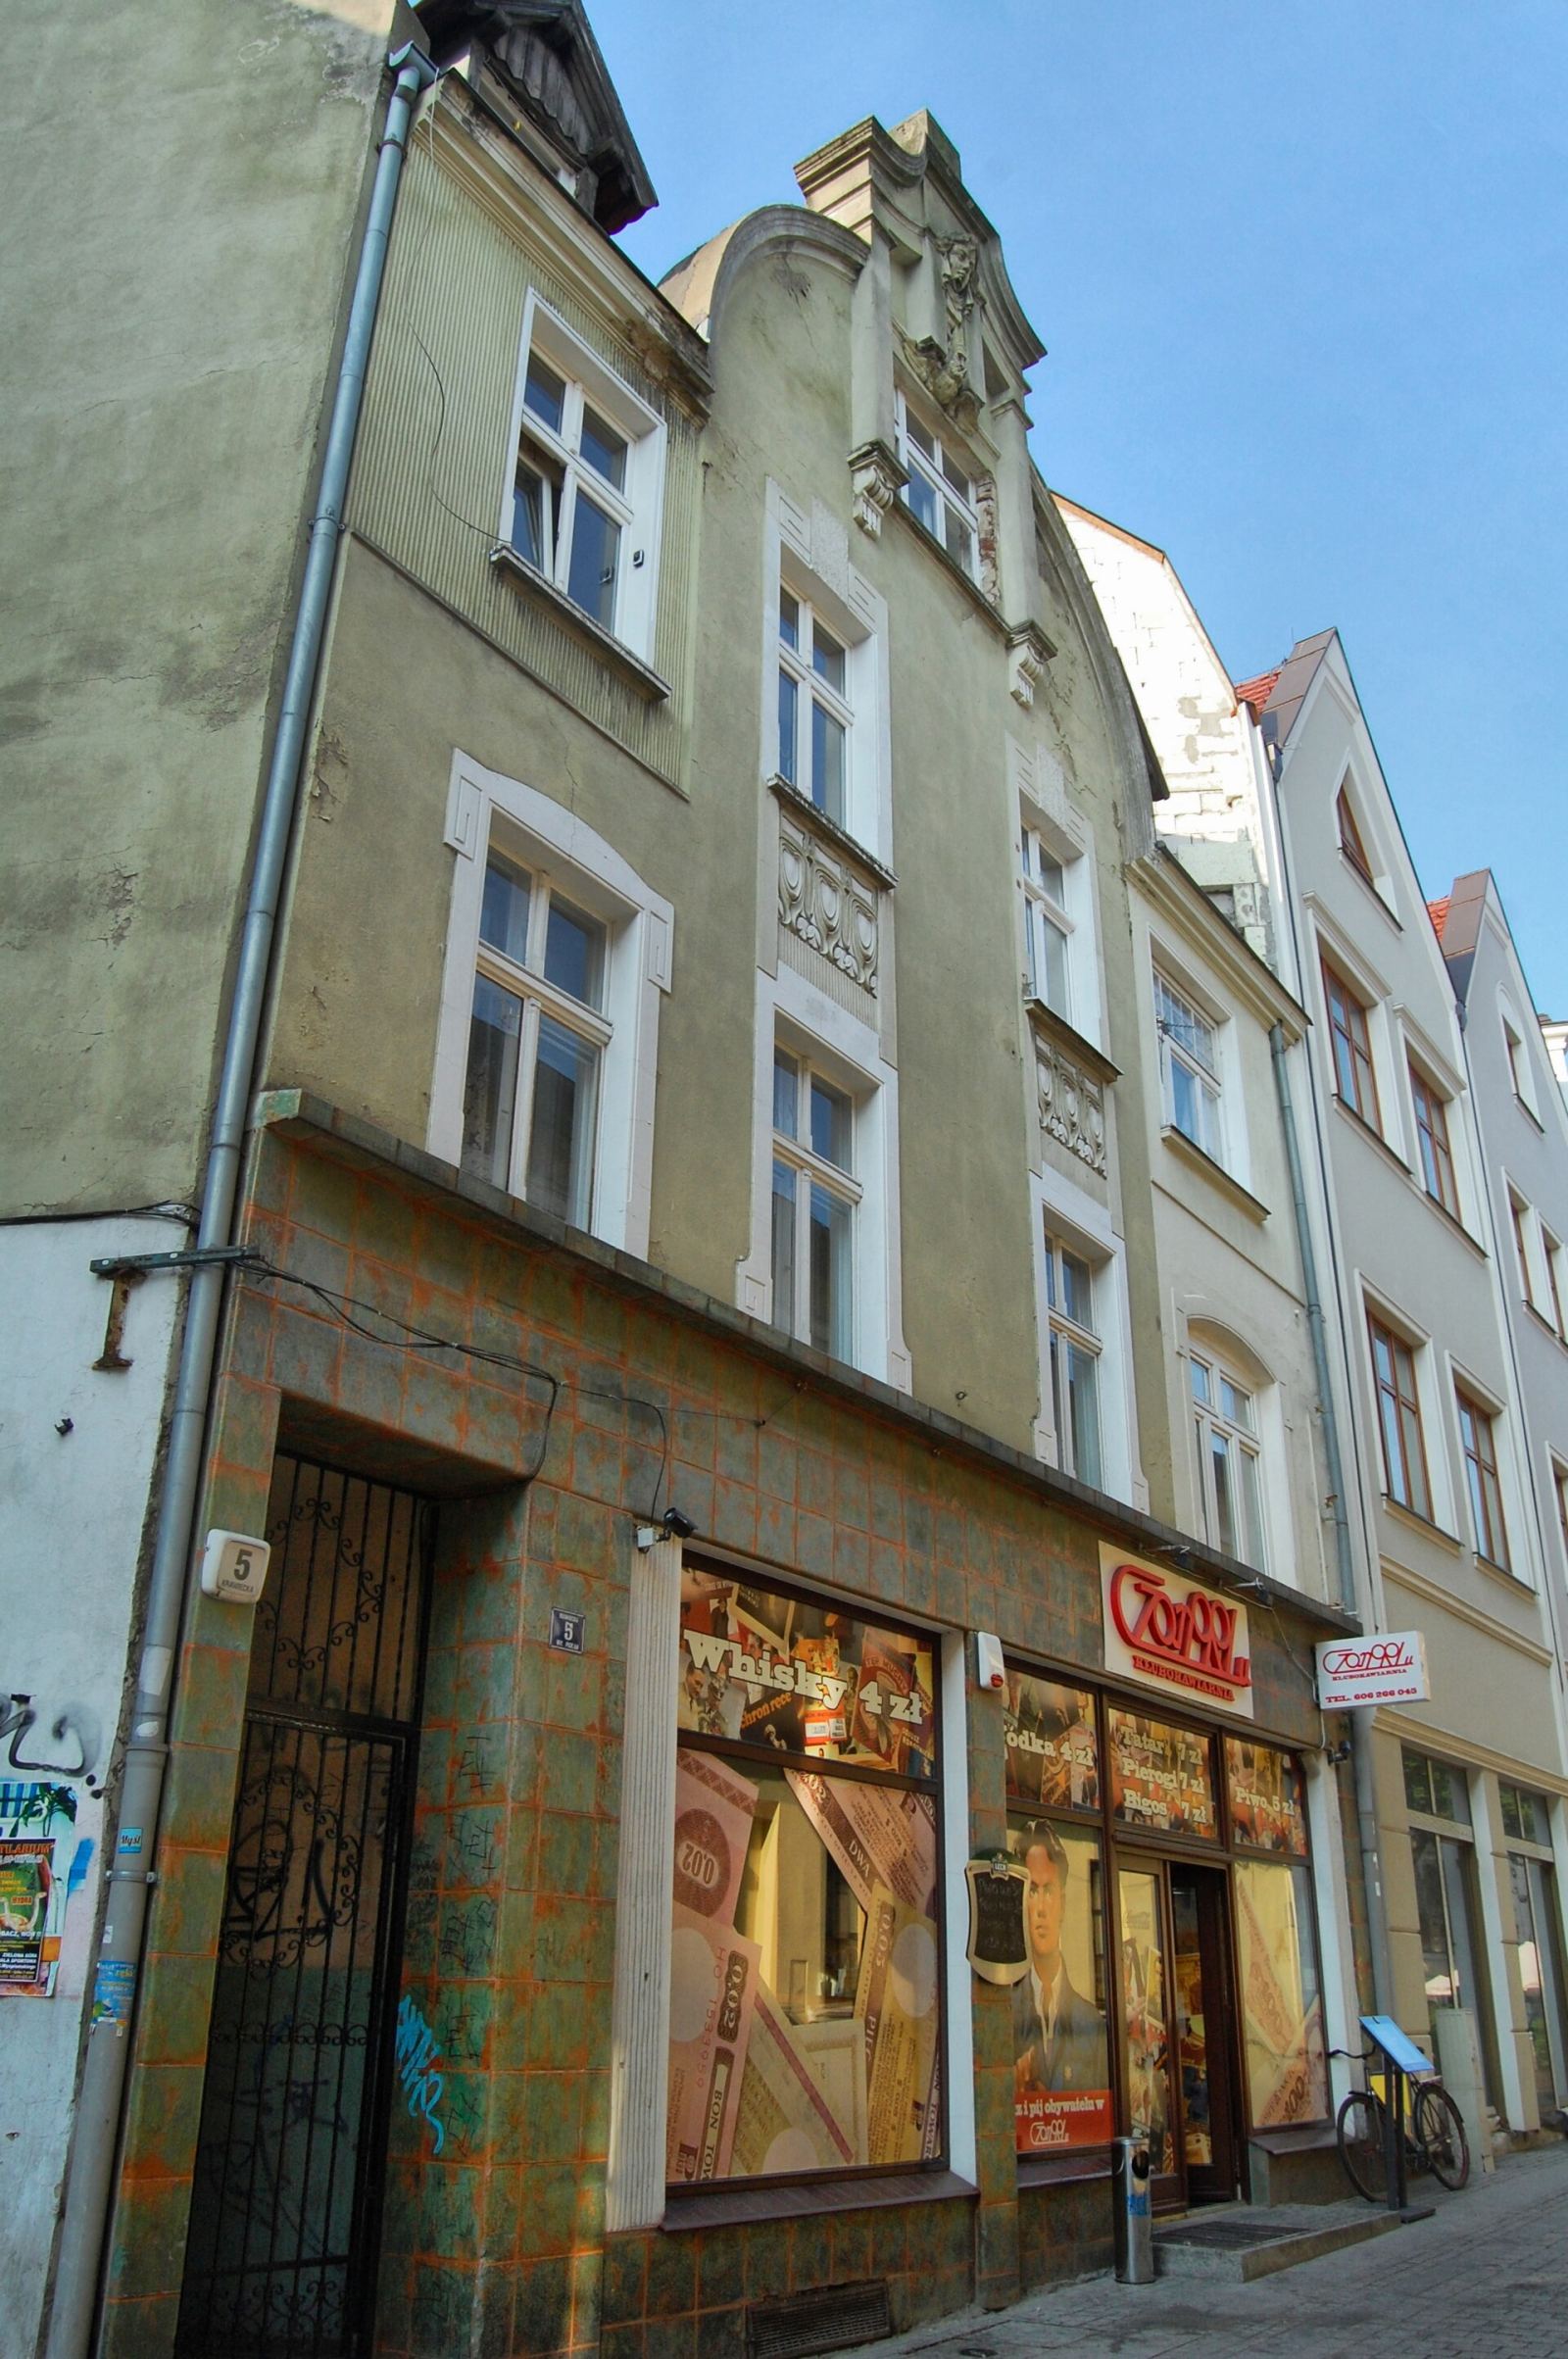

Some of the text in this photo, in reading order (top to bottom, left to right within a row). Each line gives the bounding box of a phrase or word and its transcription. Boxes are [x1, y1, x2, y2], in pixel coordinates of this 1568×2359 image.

[233, 1548, 253, 1581] 5
[564, 1621, 574, 1641] 5
[683, 1629, 848, 1710] Whisky
[858, 1680, 883, 1715] 4
[889, 1691, 923, 1725] zł
[1132, 1654, 1236, 1702] KLUBOKAWIARNIA
[1332, 1669, 1407, 1681] KLUBOKAWIARNIA
[1325, 1687, 1417, 1703] TEL. 606 266 045
[1004, 1724, 1056, 1758] ódka
[1059, 1741, 1073, 1762] 4
[1120, 1725, 1165, 1754] Tatar
[1177, 1741, 1186, 1761] 7
[1120, 1755, 1178, 1790] Pierogi
[1178, 1771, 1188, 1791] 7
[1123, 1788, 1167, 1816] Bigos
[1180, 1800, 1190, 1820] 7
[1235, 1786, 1267, 1813] Piwo
[710, 2089, 723, 2130] BON
